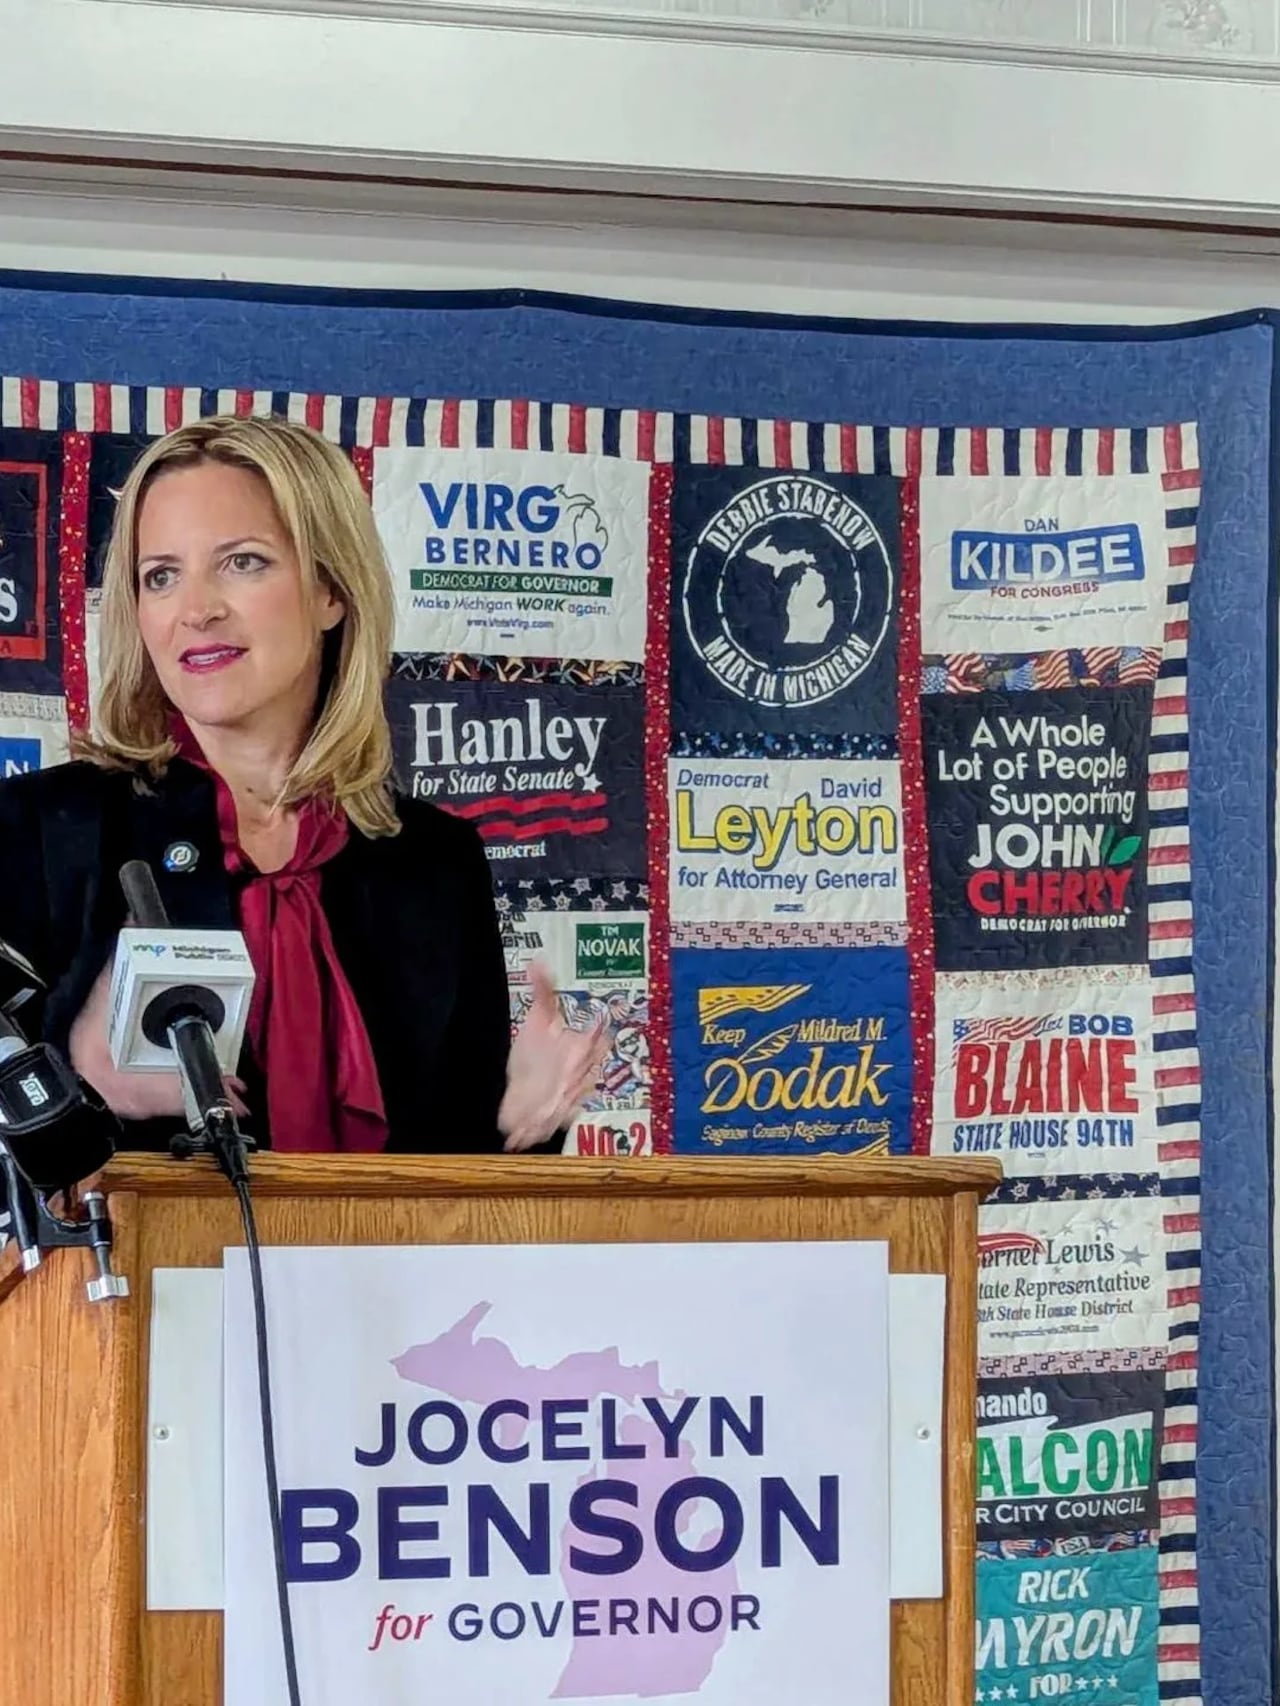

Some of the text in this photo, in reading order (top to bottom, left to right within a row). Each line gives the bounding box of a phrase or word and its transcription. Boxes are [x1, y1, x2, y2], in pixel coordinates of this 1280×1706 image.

[419, 482, 559, 533] VIRG
[706, 482, 875, 552] DEBBIE STABENOW
[1024, 517, 1059, 532] DAN
[426, 537, 601, 570] BERNERO
[960, 533, 1135, 581] KILDEE
[423, 573, 600, 593] DEMOCRAT FOR GOVERNOR
[990, 581, 1100, 599] FOR CONGRESS
[413, 596, 451, 609] Make
[453, 597, 513, 613] Michigan
[516, 597, 566, 612] WORK
[703, 633, 871, 702] MADE IN MICHIGAN
[409, 698, 607, 777] Hanley
[970, 714, 1105, 748] A Whole
[413, 766, 575, 799] for State Senate
[677, 769, 882, 798] Democrat David
[938, 747, 1127, 787] Lot of People
[990, 783, 1135, 824] Supporting
[676, 789, 898, 871] Leyton
[968, 823, 1105, 868] JOHN
[484, 840, 546, 860] emocrat
[678, 866, 897, 894] for Attorney General
[967, 868, 1133, 916] CHERRY
[981, 917, 1047, 932] DEMOCRAT
[1049, 918, 1069, 931] FOR
[577, 938, 641, 957] NOVAK
[701, 1017, 888, 1047] Keep Mildred M.
[1069, 1014, 1134, 1036] BOB
[700, 1044, 894, 1114] Dodak
[954, 1038, 1139, 1118] BLAINE
[953, 1119, 1133, 1152] STATE HOUSE 94TH
[1045, 1234, 1115, 1265] Lewis
[1015, 1271, 1151, 1300] Representative
[997, 1298, 1133, 1321] State House District
[354, 1395, 765, 1467] JOCELYN
[995, 1504, 1048, 1524] CITY
[1055, 1497, 1145, 1519] COUNCIL
[280, 1475, 840, 1584] BENSON
[1017, 1566, 1092, 1604] RICK
[368, 1595, 762, 1652] for GOVERNOR
[1029, 1673, 1072, 1699] FOR
